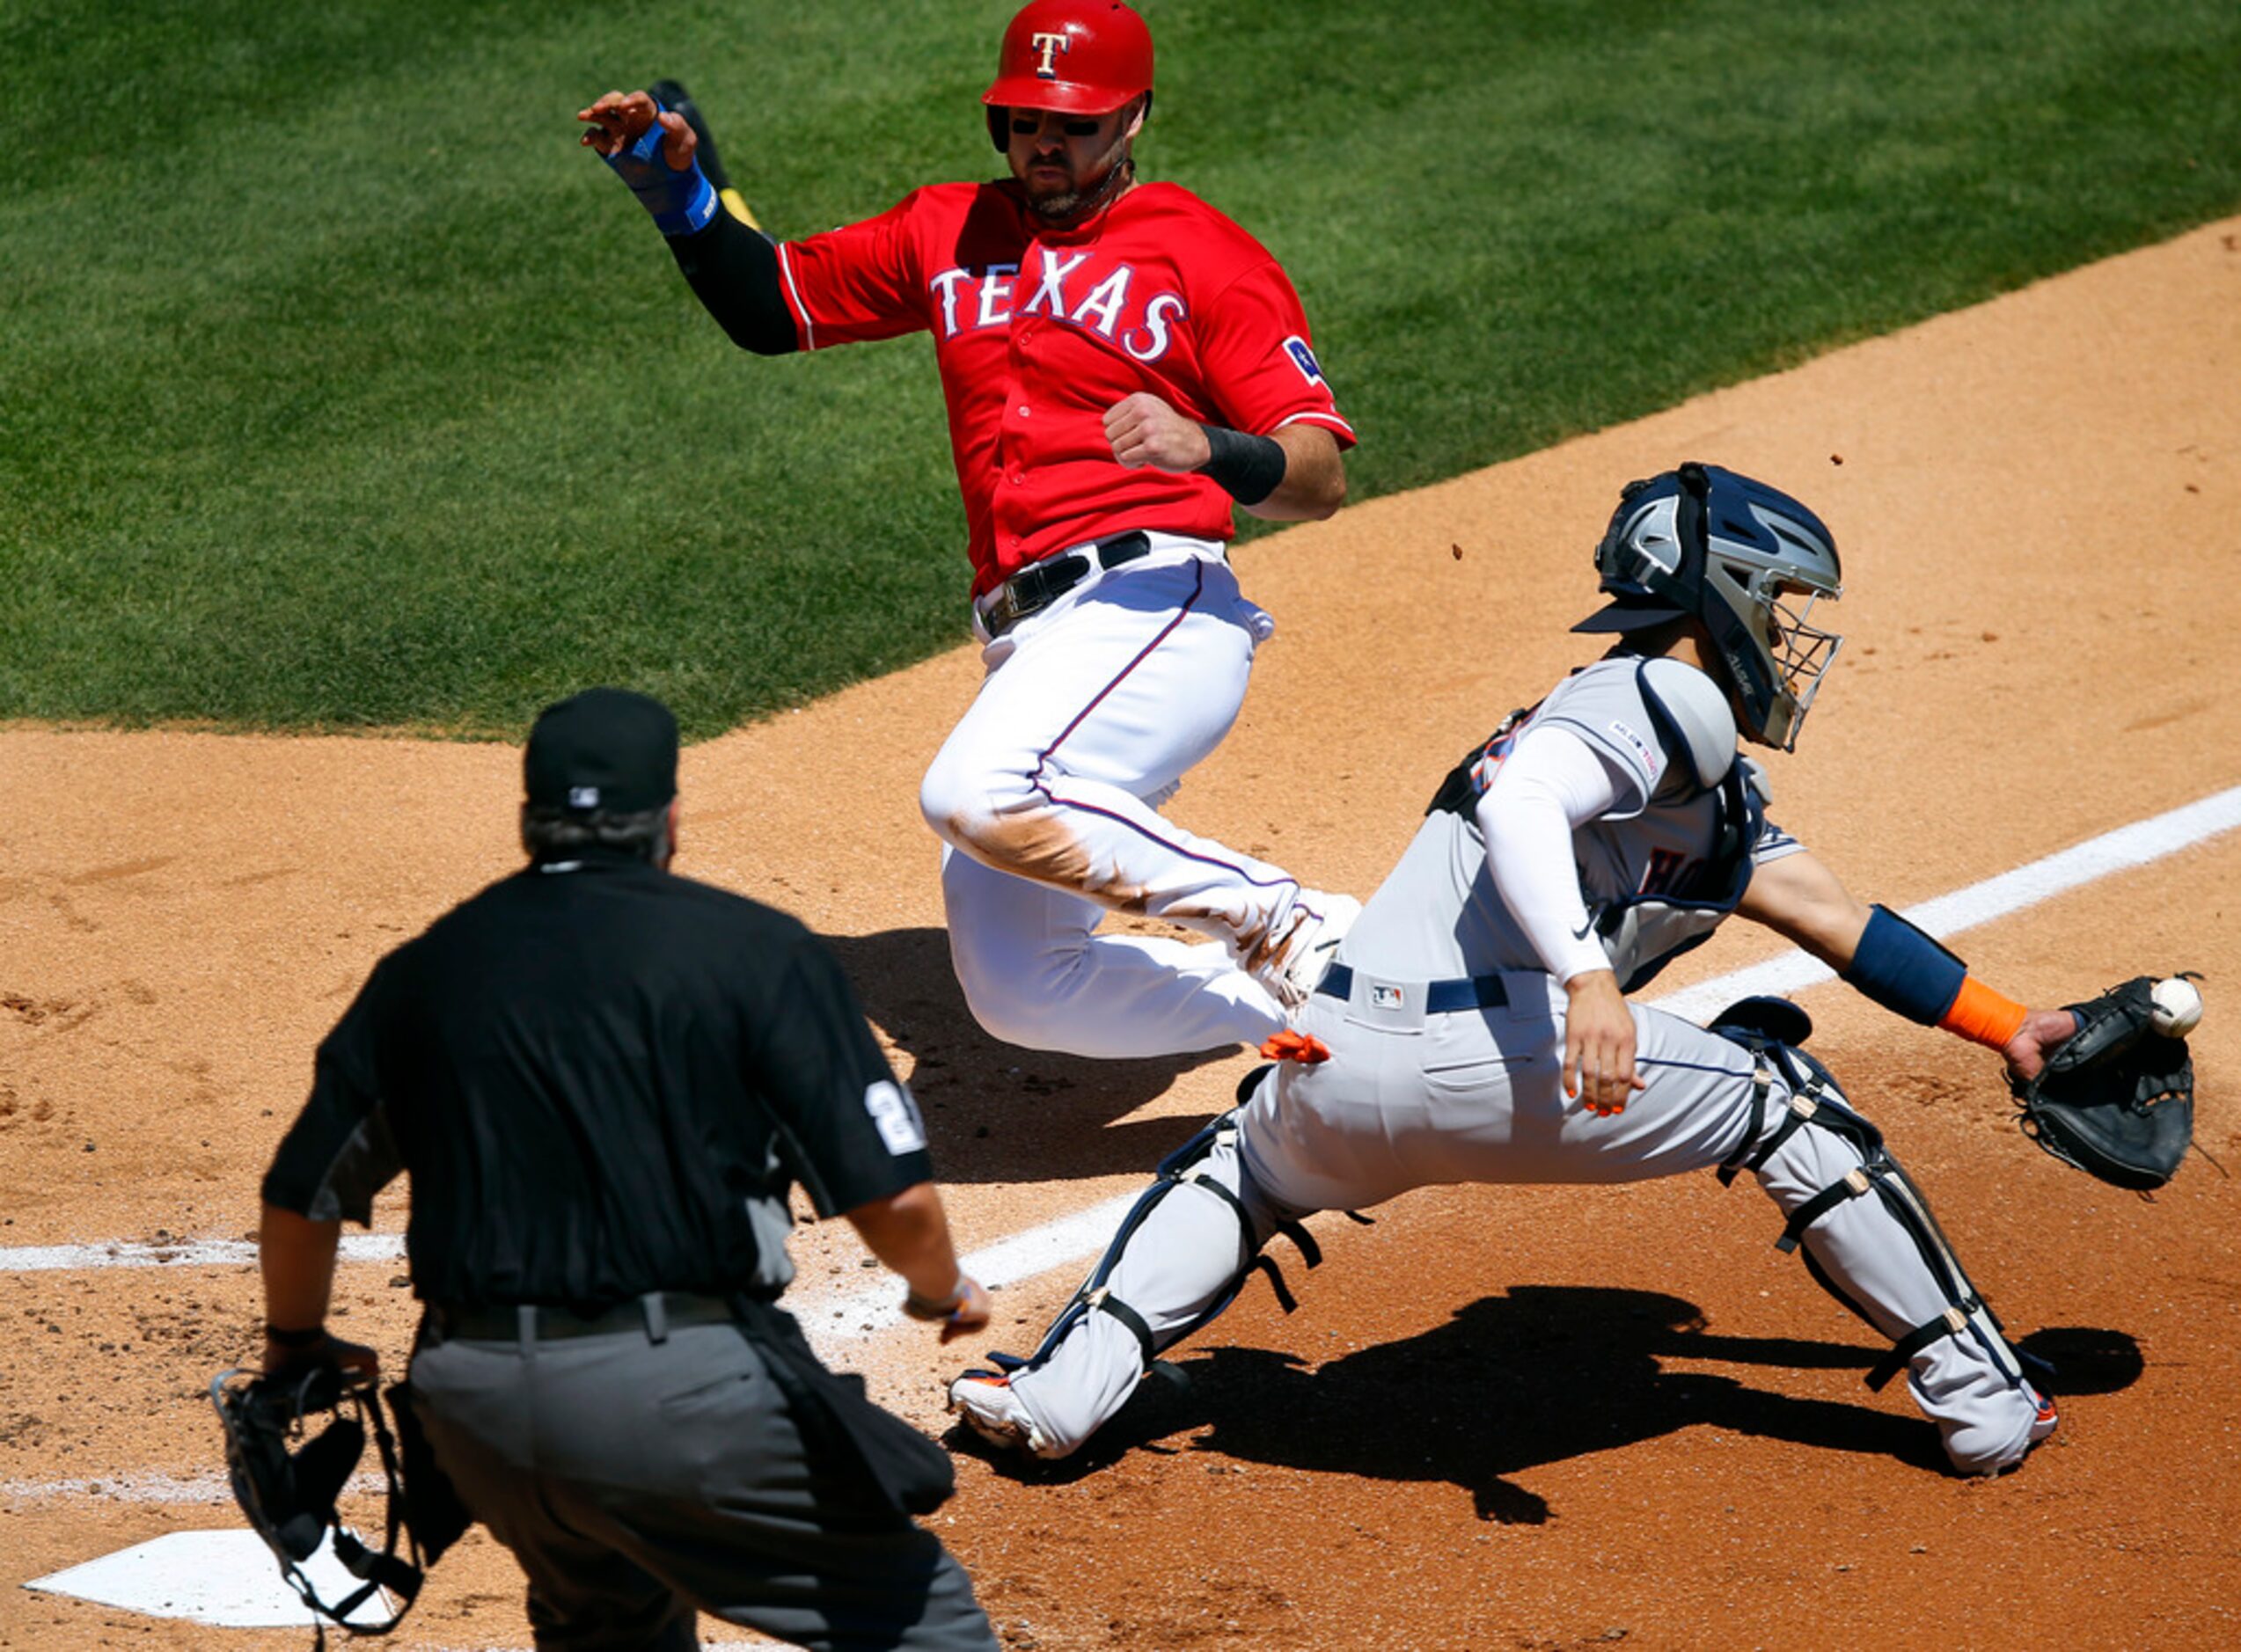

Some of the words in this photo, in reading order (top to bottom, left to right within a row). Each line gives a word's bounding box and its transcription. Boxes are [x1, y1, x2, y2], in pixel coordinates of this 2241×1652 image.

[1032, 33, 1069, 79] T
[930, 247, 1189, 364] TEXAS
[864, 1080, 927, 1156] 2
